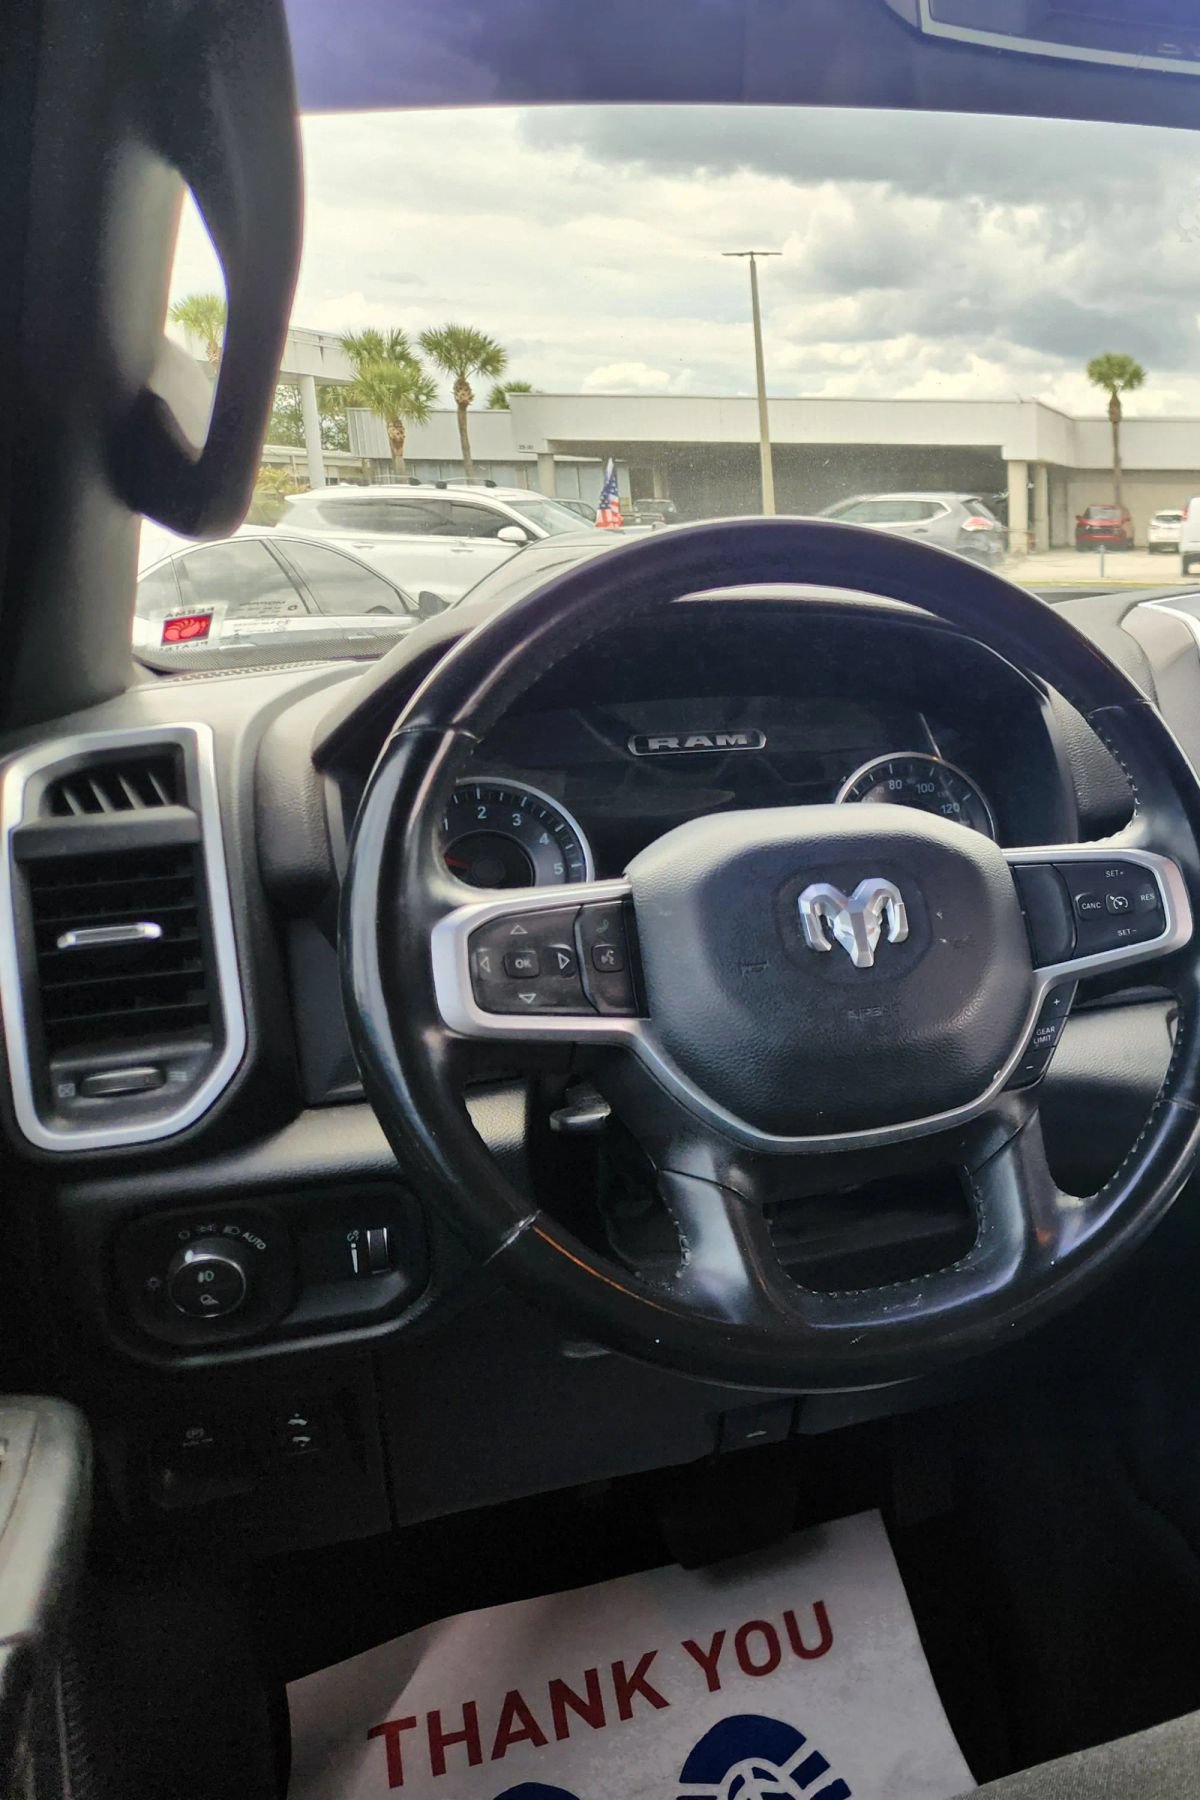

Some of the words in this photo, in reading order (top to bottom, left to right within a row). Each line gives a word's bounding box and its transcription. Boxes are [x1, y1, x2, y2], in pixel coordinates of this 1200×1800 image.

[648, 733, 748, 750] RAM
[888, 779, 902, 790] 80
[915, 782, 935, 794] 100
[477, 806, 487, 820] 2
[941, 802, 960, 814] 120
[512, 813, 522, 826] 3
[539, 832, 550, 845] 4
[553, 863, 564, 875] 5
[1140, 893, 1155, 901] RES
[1081, 902, 1102, 910] CANC
[514, 959, 532, 969] OK
[1033, 1035, 1051, 1044] LIMIT
[242, 1231, 267, 1251] AUTO
[366, 1649, 671, 1790] THANK
[680, 1600, 834, 1693] YOU
